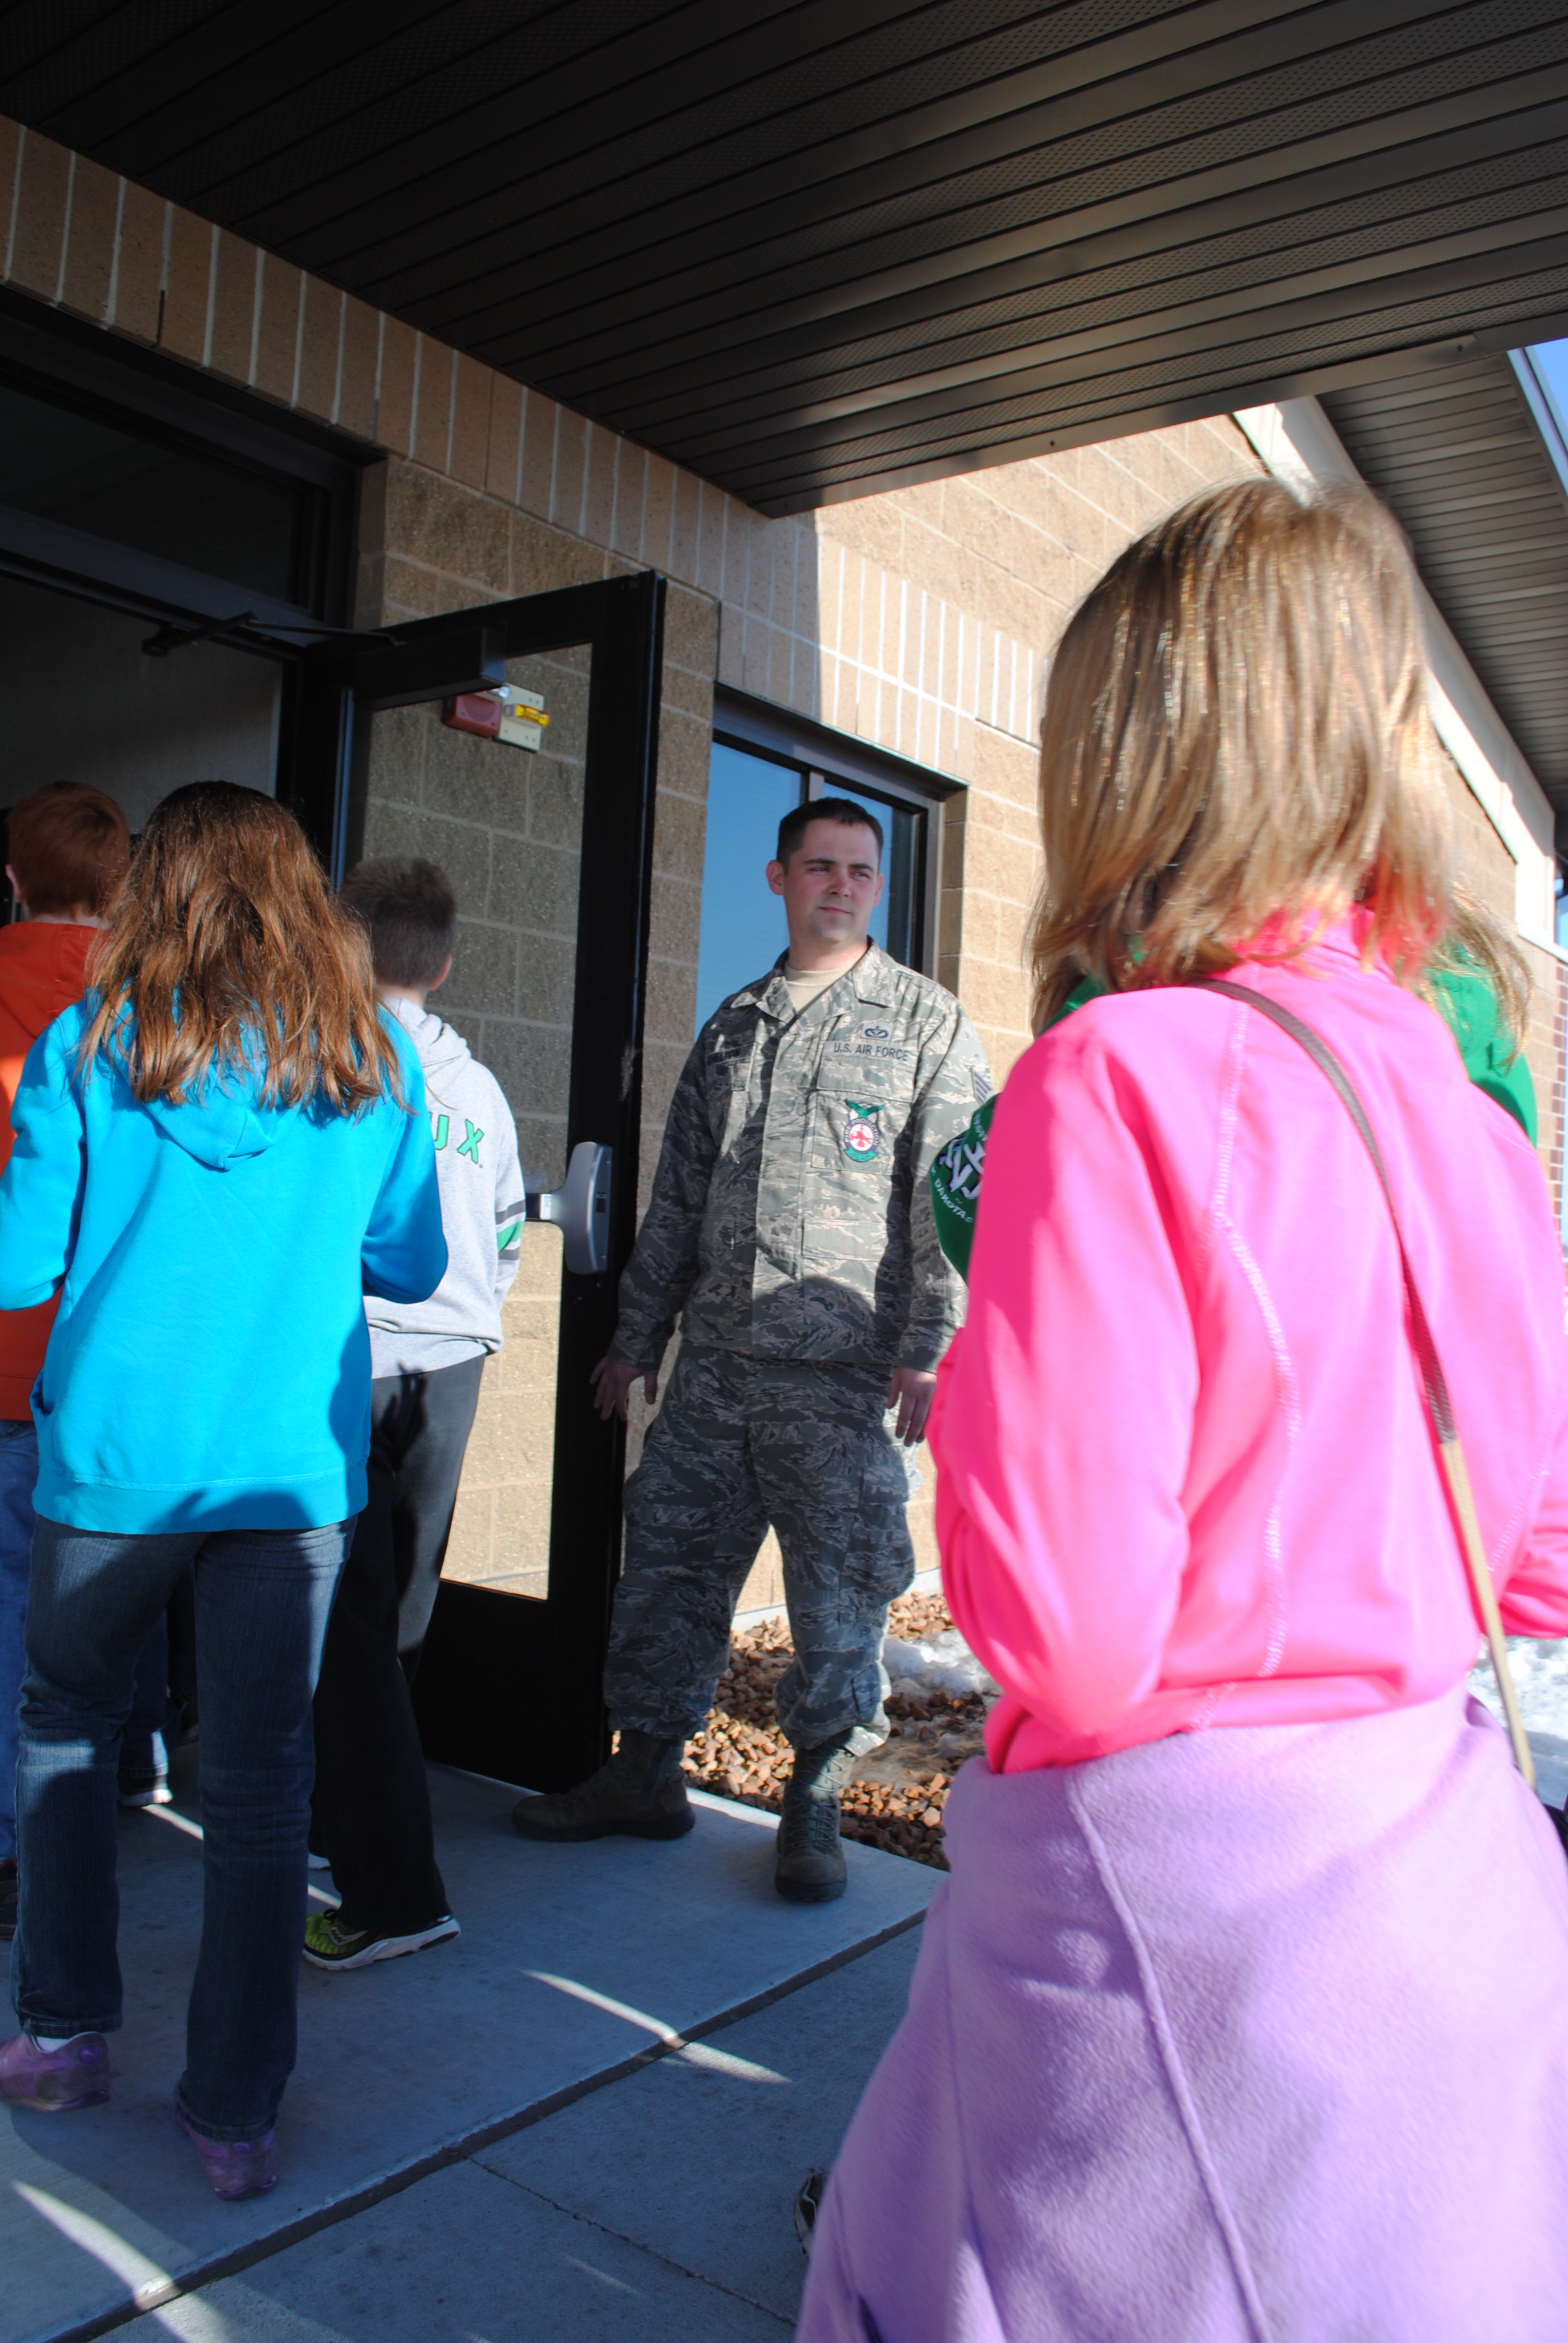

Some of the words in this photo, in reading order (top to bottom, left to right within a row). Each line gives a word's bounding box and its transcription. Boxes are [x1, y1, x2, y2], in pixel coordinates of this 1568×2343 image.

[834, 1042, 852, 1053] U.S.
[855, 1044, 872, 1054] AIR
[875, 1045, 908, 1061] FORCE
[934, 1178, 966, 1218] DAKOTA
